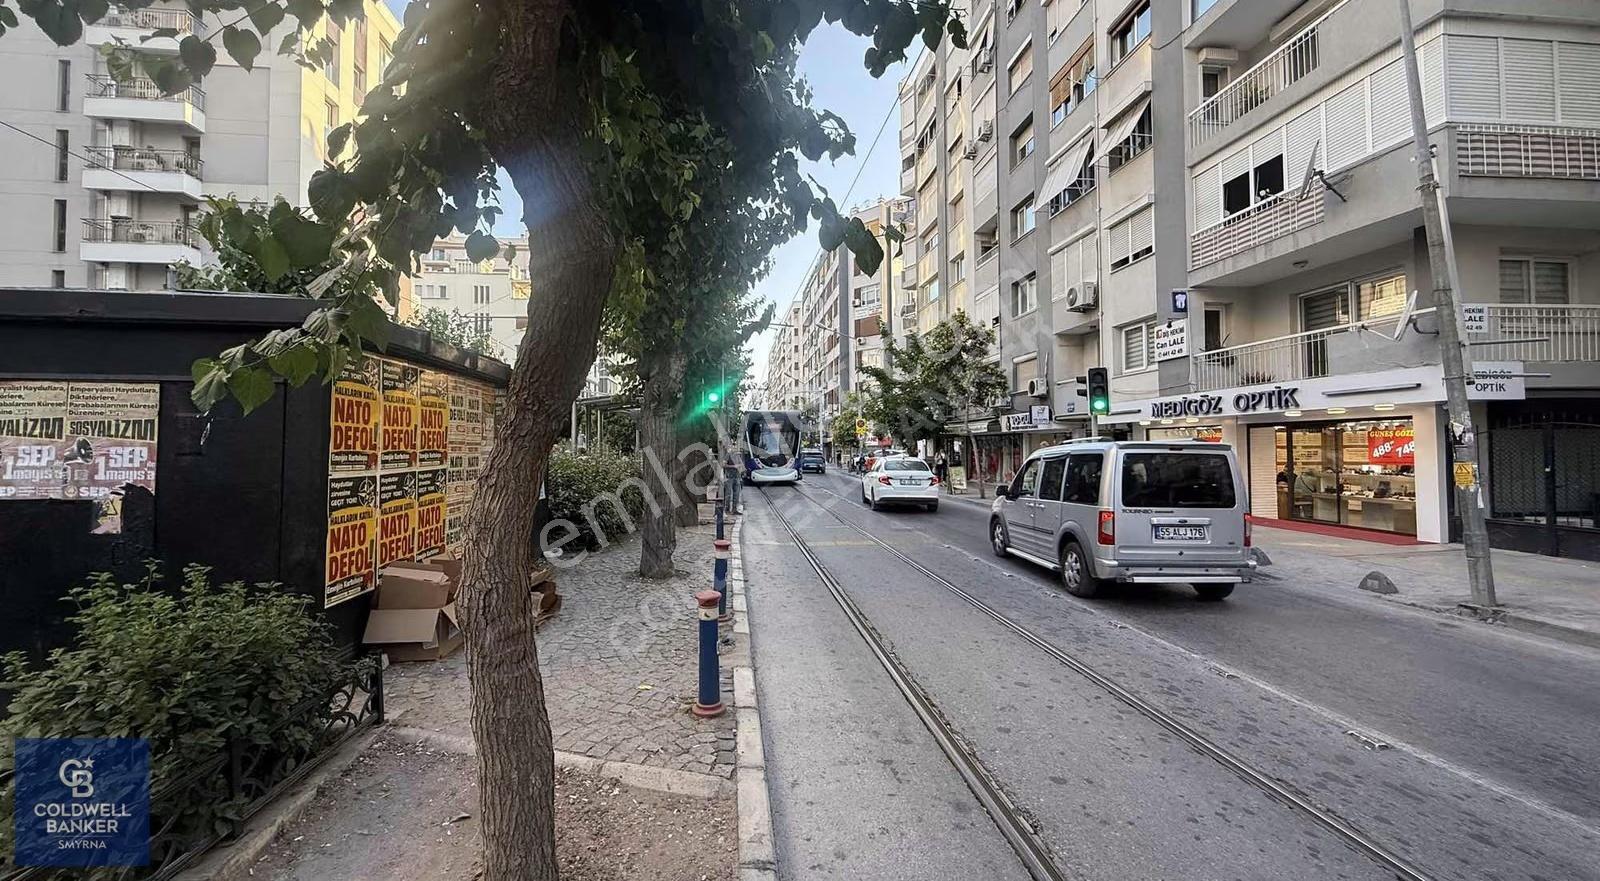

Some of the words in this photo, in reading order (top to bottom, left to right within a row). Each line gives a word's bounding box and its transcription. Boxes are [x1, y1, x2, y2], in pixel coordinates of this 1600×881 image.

[1169, 337, 1184, 346] LALE
[1475, 382, 1506, 392] OPTİK
[335, 398, 370, 425] NATO
[1152, 395, 1222, 418] MEDİGÖZ
[1233, 386, 1300, 412] OPTİK
[383, 405, 411, 427] NATO
[421, 409, 443, 429] NATO
[333, 422, 378, 451] DEFOL!
[383, 424, 417, 450] DEFOL!
[421, 426, 448, 450] DEFOL!
[3, 455, 14, 480] 1
[16, 446, 56, 466] SEP
[109, 447, 148, 467] SEP
[95, 457, 106, 480] 1
[380, 513, 409, 540] NATO
[418, 506, 440, 529] NATO
[330, 522, 366, 554] NATO
[418, 519, 446, 551] DEFOL!
[1160, 528, 1170, 536] 55
[1173, 528, 1188, 536] ALJ
[380, 527, 415, 564] DEFOL!
[329, 539, 374, 582] DEFOL!
